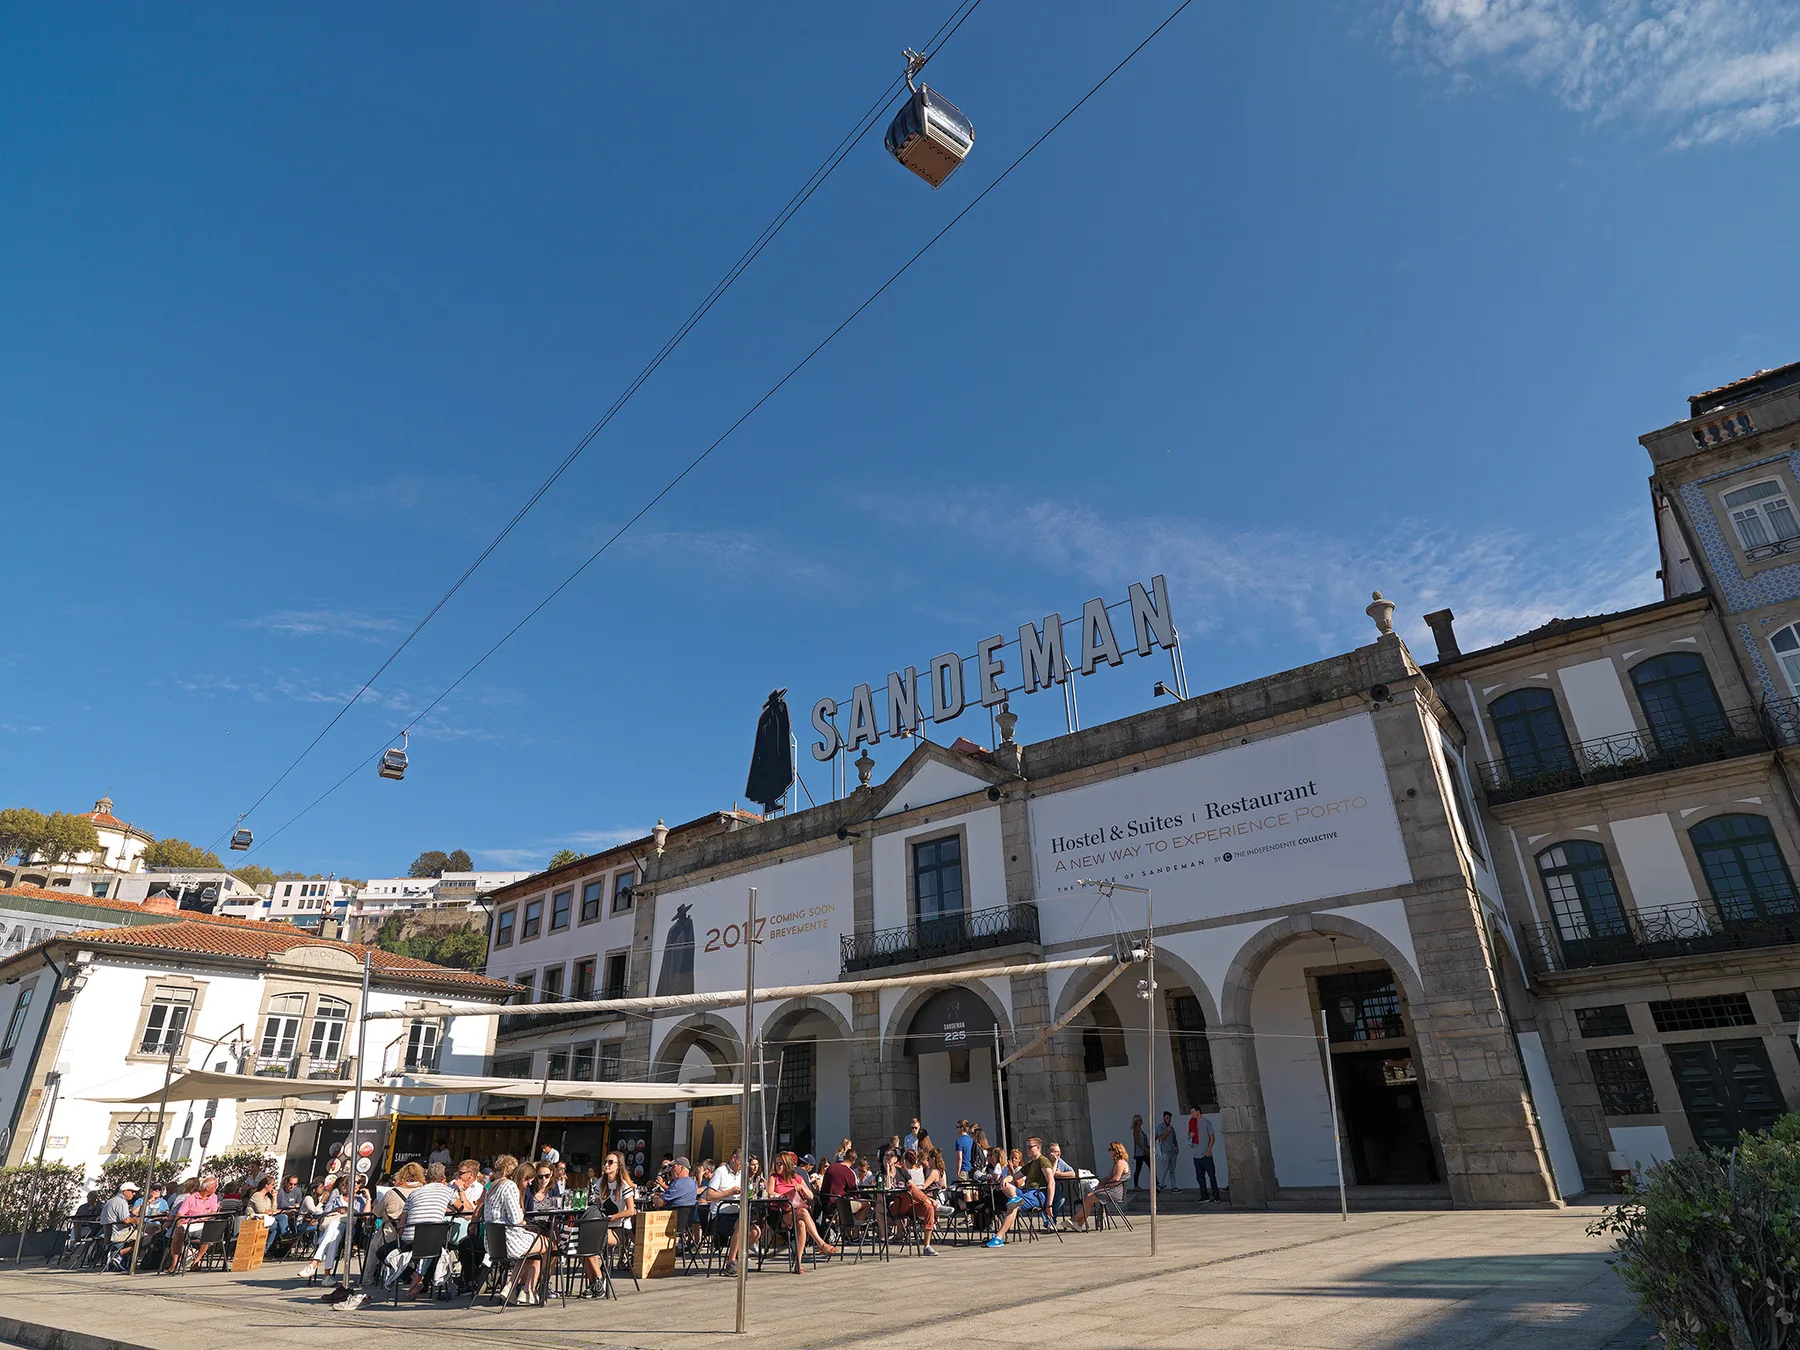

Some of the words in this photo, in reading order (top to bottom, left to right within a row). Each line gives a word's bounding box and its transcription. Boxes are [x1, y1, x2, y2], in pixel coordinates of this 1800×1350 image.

[811, 574, 1176, 762] SANDEMAN
[1051, 828, 1106, 854] Hostel
[1109, 825, 1124, 843] &
[1127, 813, 1183, 838] Suites
[1204, 780, 1319, 820] Restaurant
[1055, 860, 1067, 873] A
[1070, 853, 1106, 870] NEW
[1109, 845, 1142, 862] WAY
[1145, 840, 1168, 853] TO
[1172, 812, 1291, 849] EXPERIENCE
[1295, 796, 1367, 822] PORTO
[1234, 850, 1246, 859] THE
[1246, 840, 1297, 856] INDEPENDENTE
[1298, 831, 1338, 845] COLLECTIVE
[1057, 885, 1074, 893] THE
[1142, 860, 1205, 877] SANDEMAN
[770, 909, 806, 925] COMING
[809, 903, 836, 917] SOON
[704, 917, 767, 953] 2017
[770, 919, 829, 940] BREVEMENTE
[943, 1021, 966, 1030] SANDEMAN
[944, 1030, 967, 1042] 225
